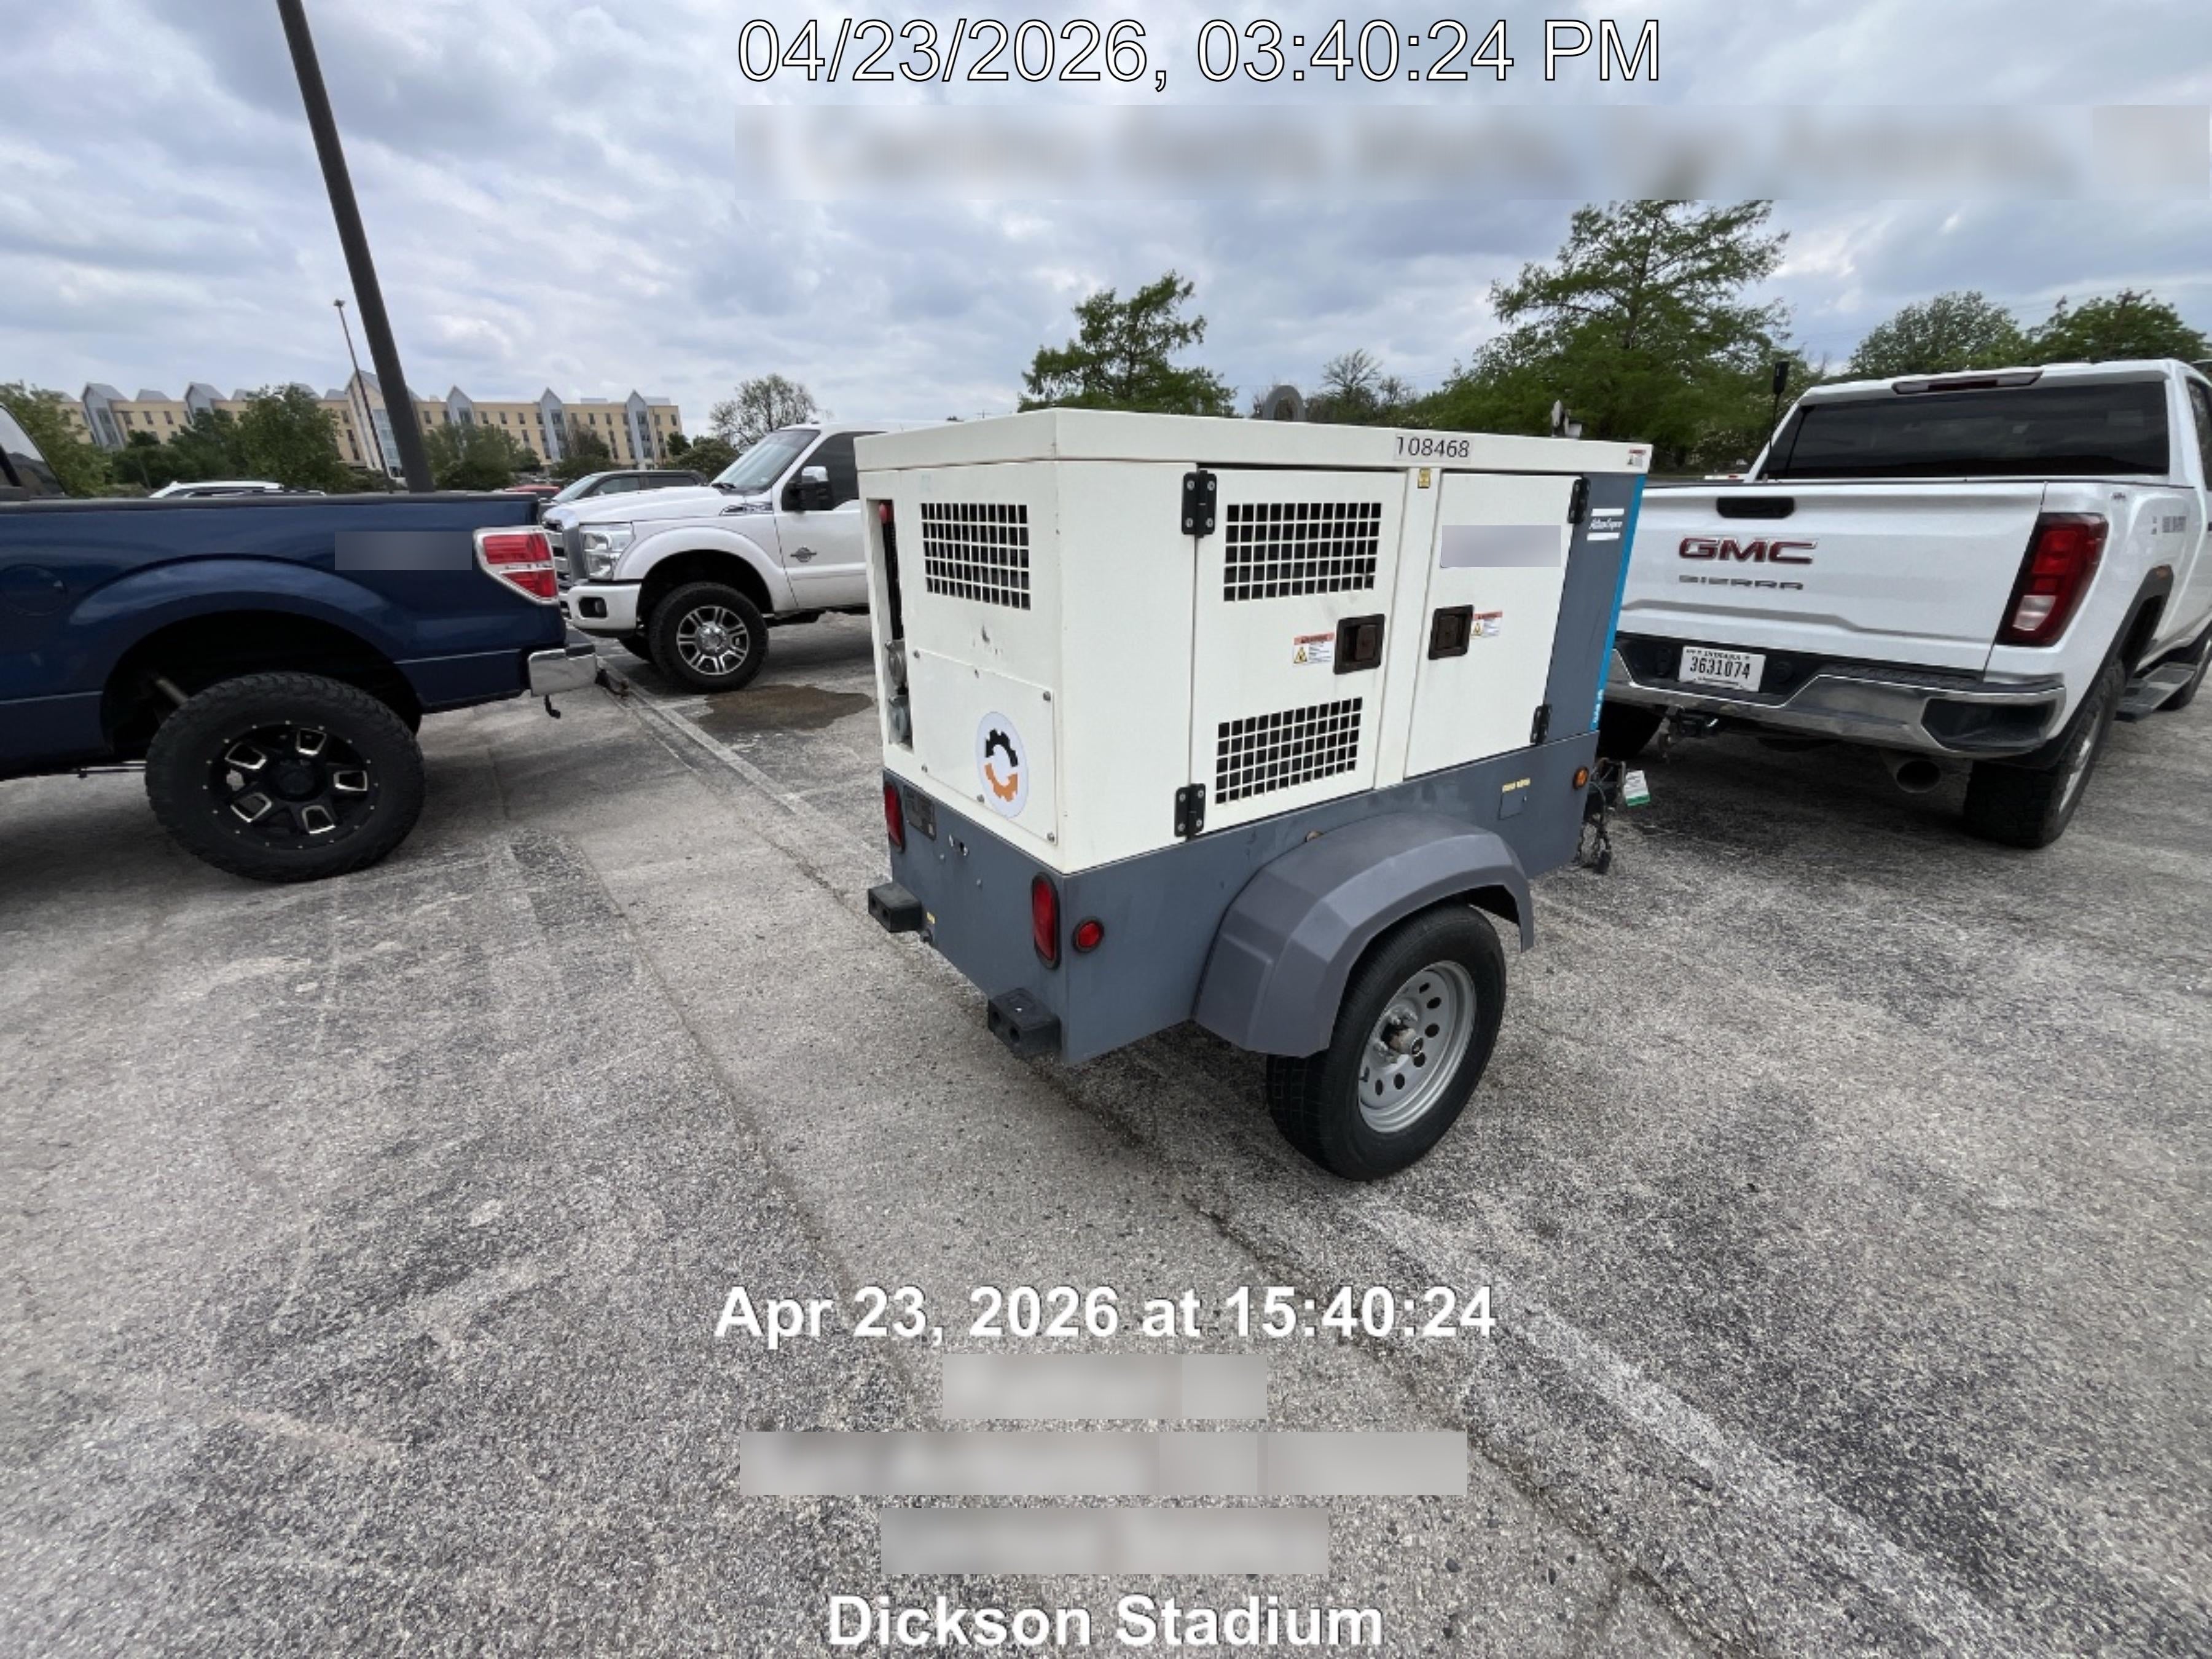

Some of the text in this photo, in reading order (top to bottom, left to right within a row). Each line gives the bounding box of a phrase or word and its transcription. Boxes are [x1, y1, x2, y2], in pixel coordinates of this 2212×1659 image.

[1396, 436, 1469, 458] 108468
[1679, 537, 1818, 565] GMC
[1690, 656, 1751, 679] 3631074
